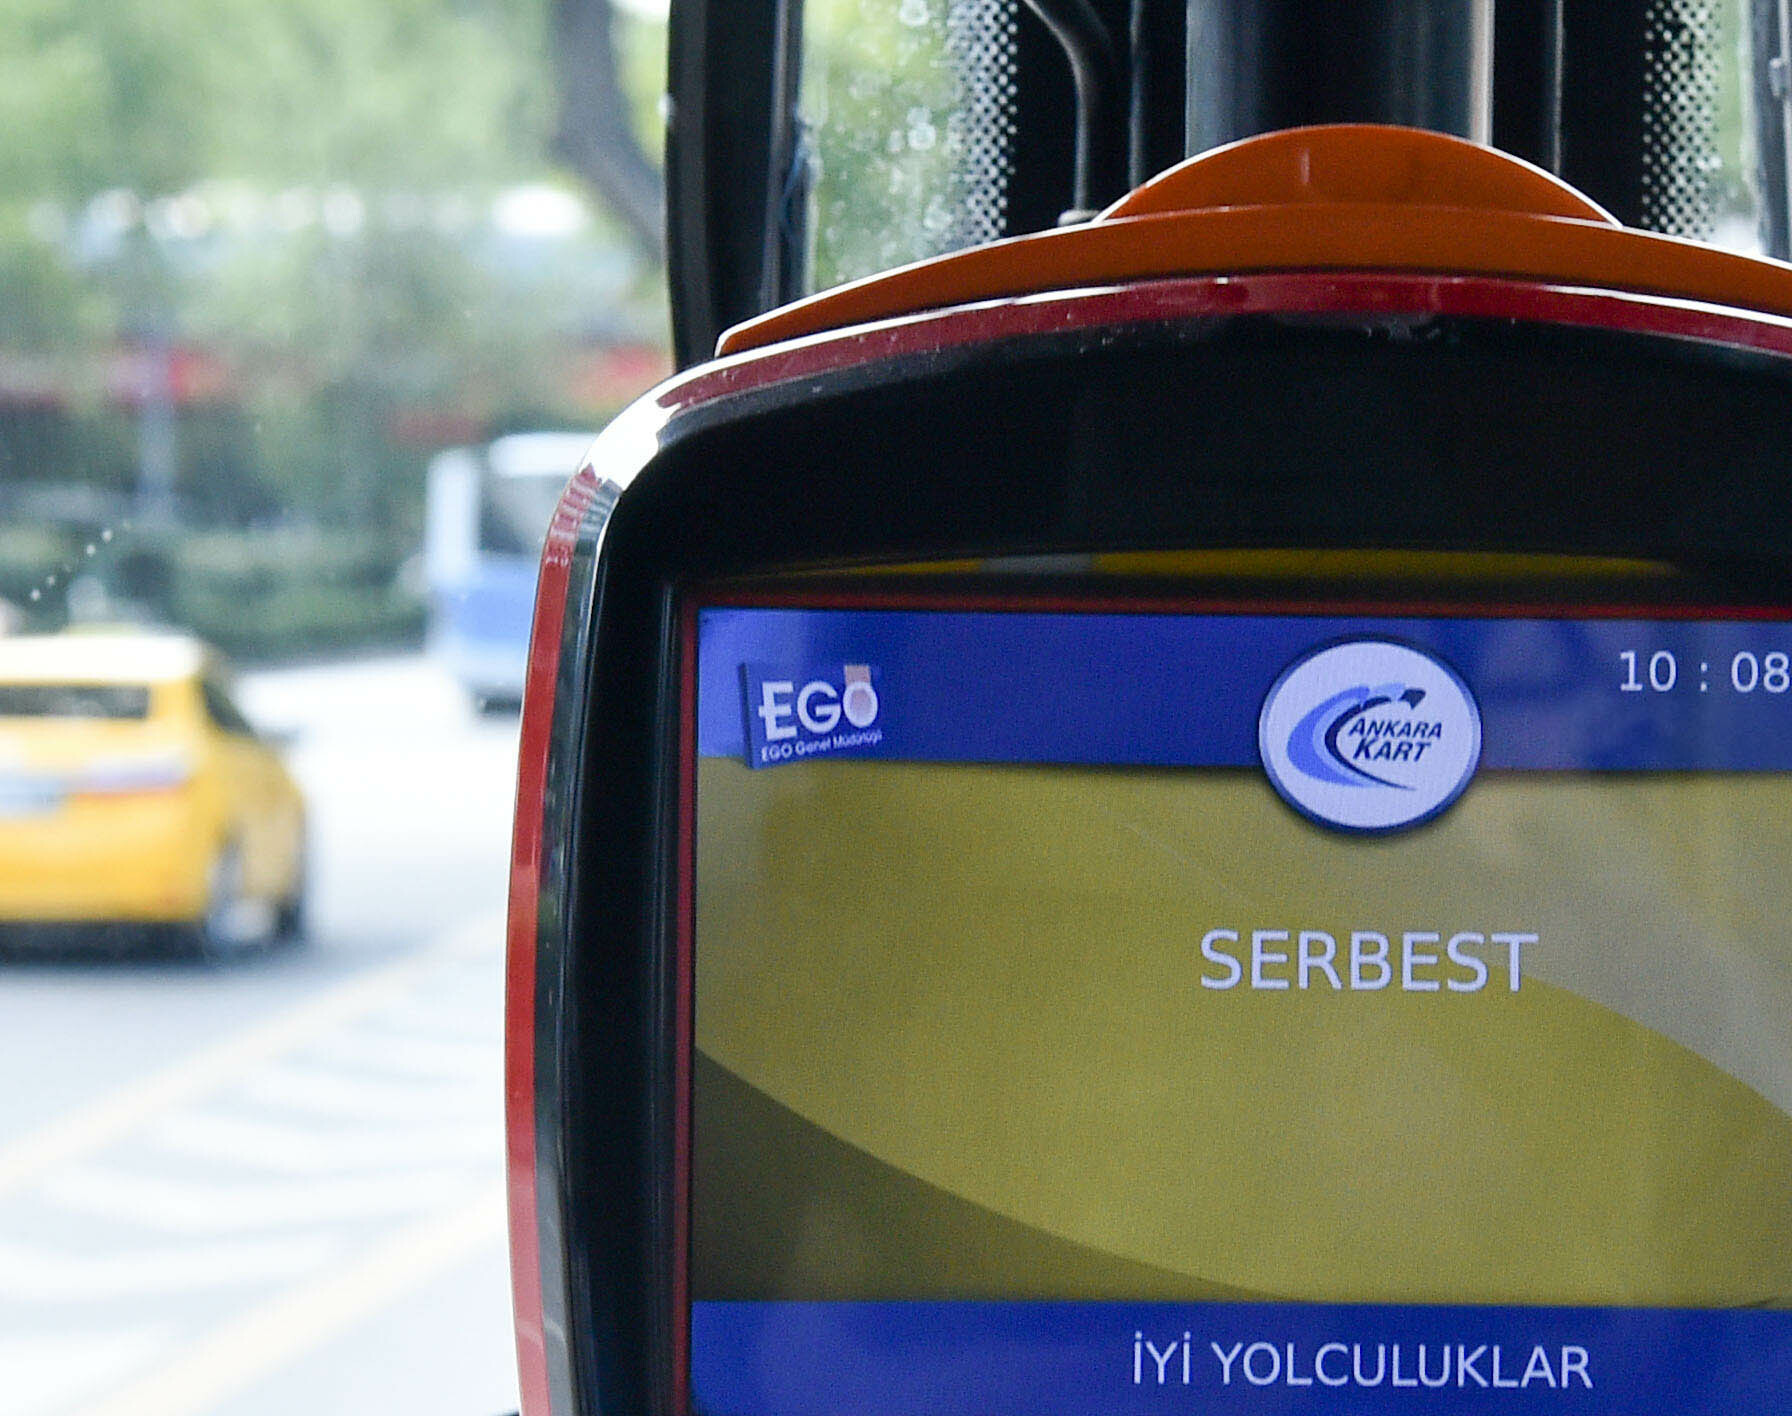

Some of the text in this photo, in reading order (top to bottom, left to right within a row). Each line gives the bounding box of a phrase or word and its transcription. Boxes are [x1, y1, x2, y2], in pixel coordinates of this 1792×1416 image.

[1618, 650, 1678, 693] 10
[1730, 651, 1791, 694] 08
[758, 680, 879, 741] EGO
[1349, 717, 1444, 739] ANKARA
[760, 742, 794, 763] EGO
[1352, 738, 1432, 763] KART
[1200, 927, 1540, 993] SERBEST
[1133, 1330, 1595, 1390] İYİ YOLCULUKLAR
